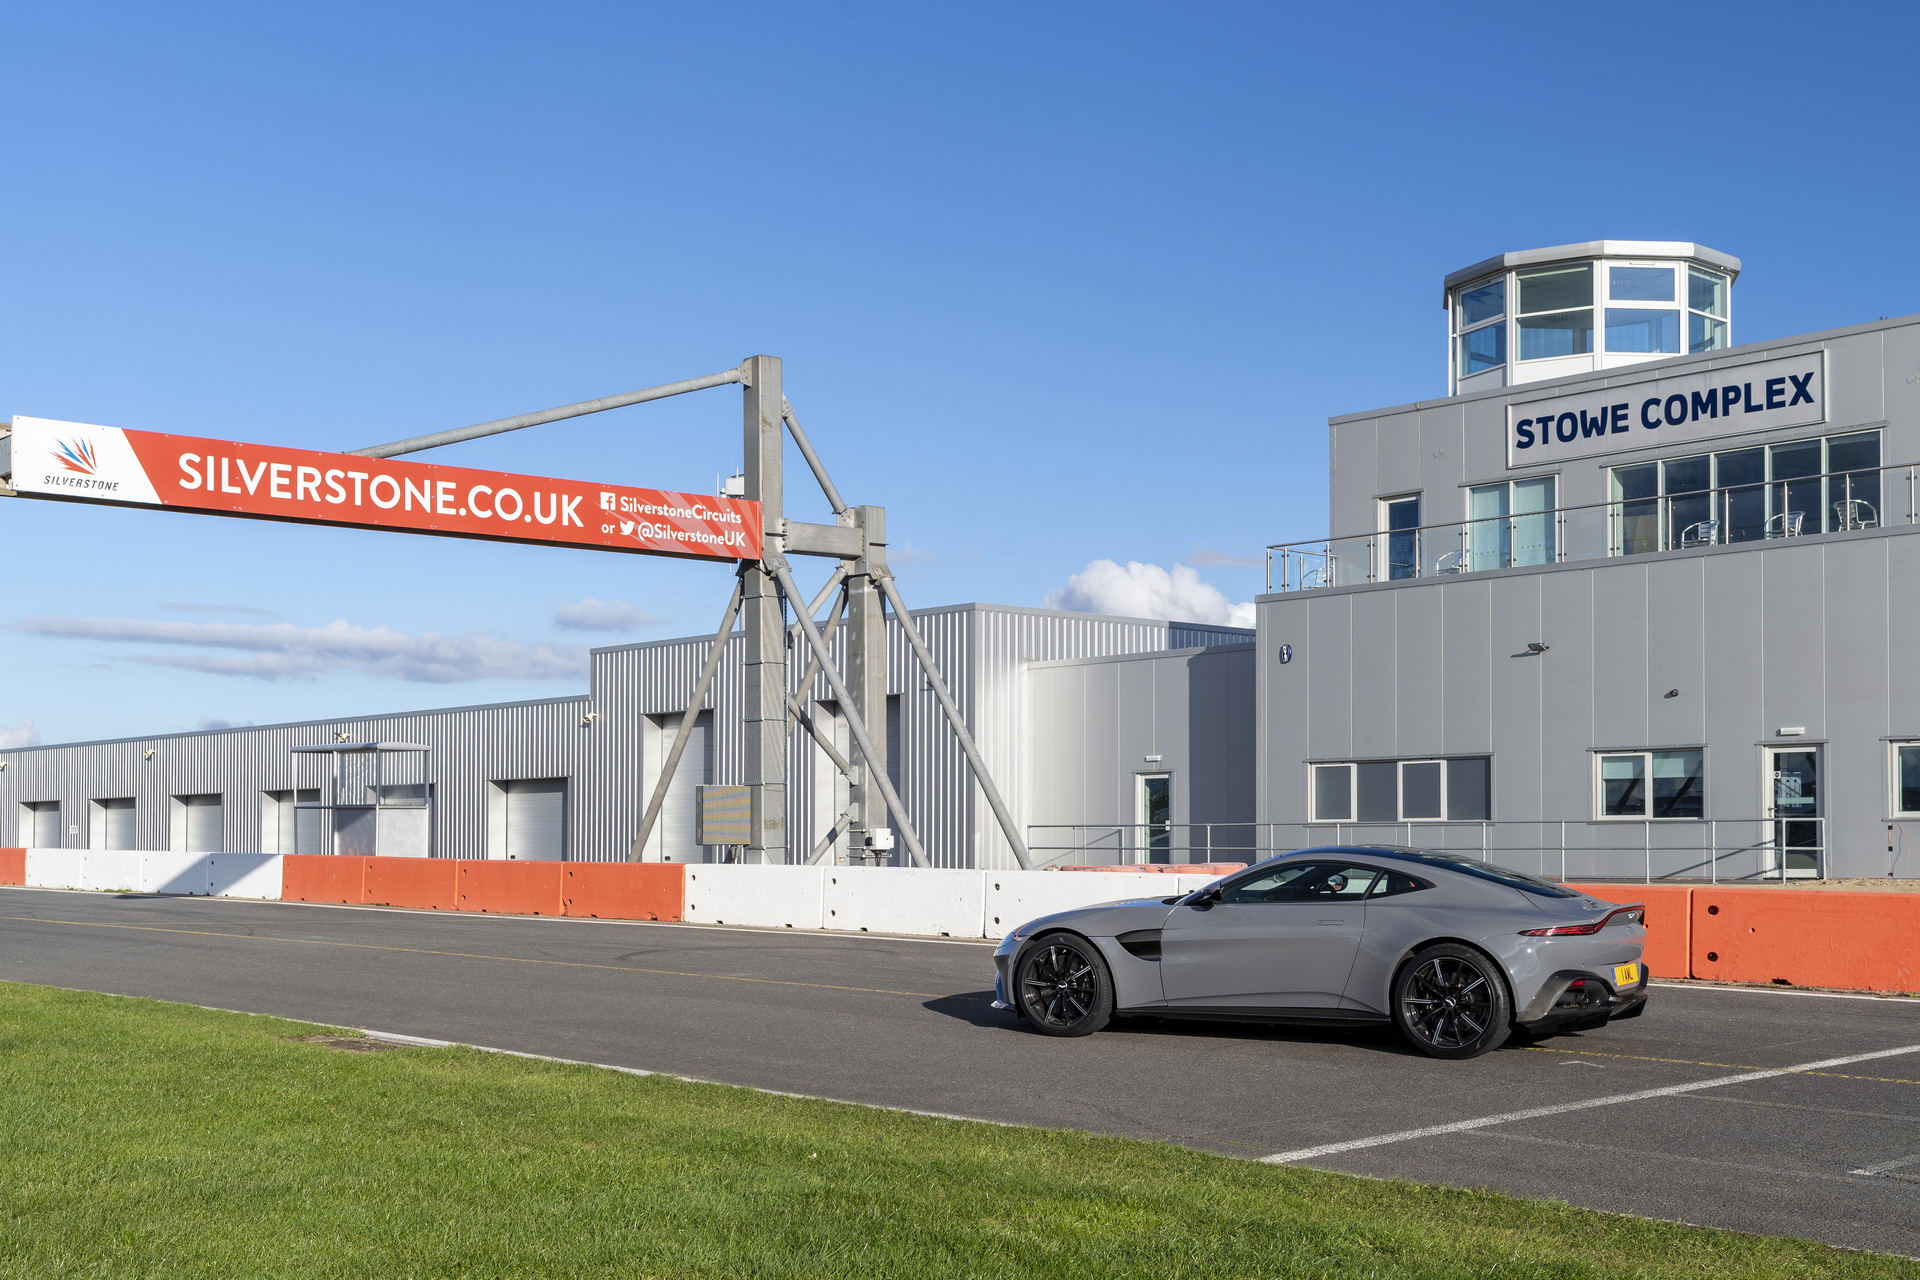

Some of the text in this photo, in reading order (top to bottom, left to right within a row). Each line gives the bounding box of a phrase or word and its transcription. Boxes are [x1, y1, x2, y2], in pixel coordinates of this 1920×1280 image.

[1515, 371, 1815, 450] STOWE COMPLEX
[43, 475, 119, 492] SILVERSTONE
[178, 452, 584, 528] SILVERSTONE.CO.UK
[620, 496, 742, 524] SilverstoneCircuits
[601, 522, 746, 547] or @SilverstoneUK
